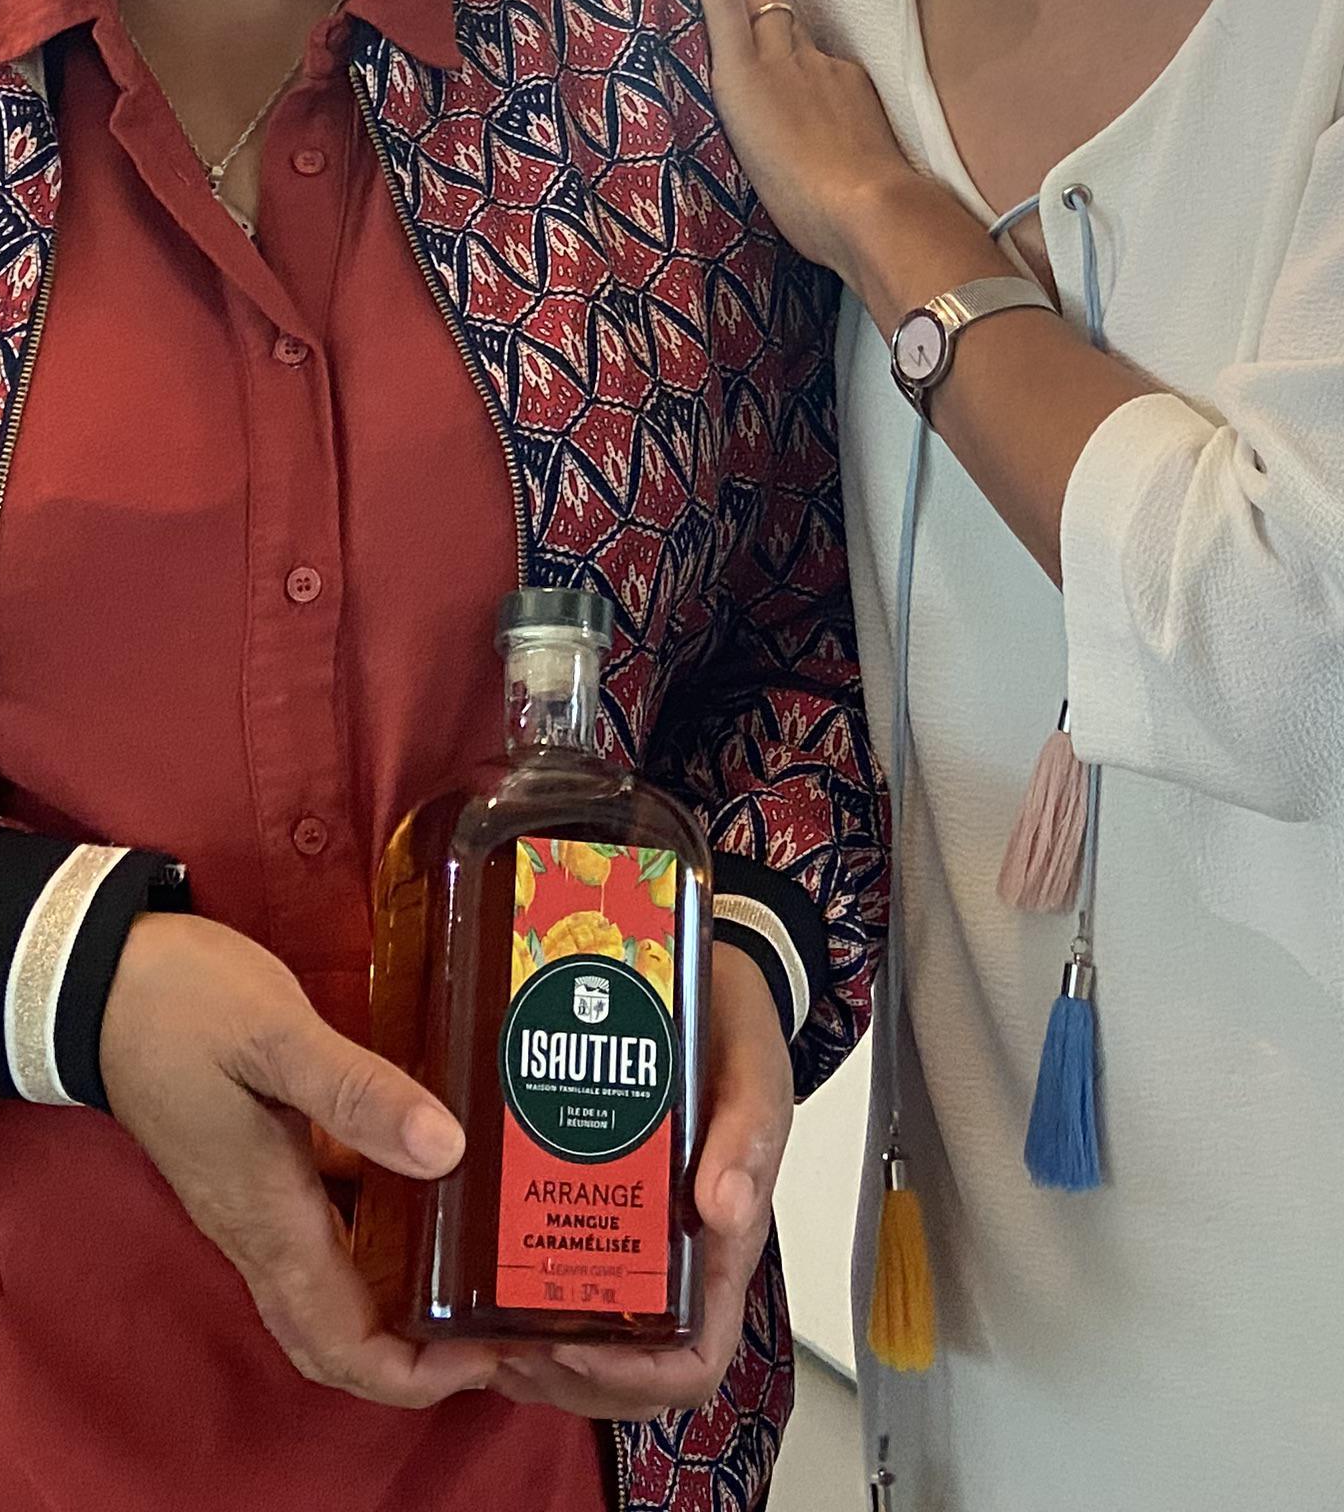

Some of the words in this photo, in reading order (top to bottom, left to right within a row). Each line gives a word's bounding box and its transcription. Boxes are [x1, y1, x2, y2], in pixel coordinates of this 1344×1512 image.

[520, 1029, 657, 1087] ISAUTIER
[582, 1108, 594, 1117] DE
[524, 1179, 644, 1209] ARRANGÉ
[546, 1213, 620, 1230] MANGUE
[523, 1233, 641, 1254] CARAMÉLISÉE
